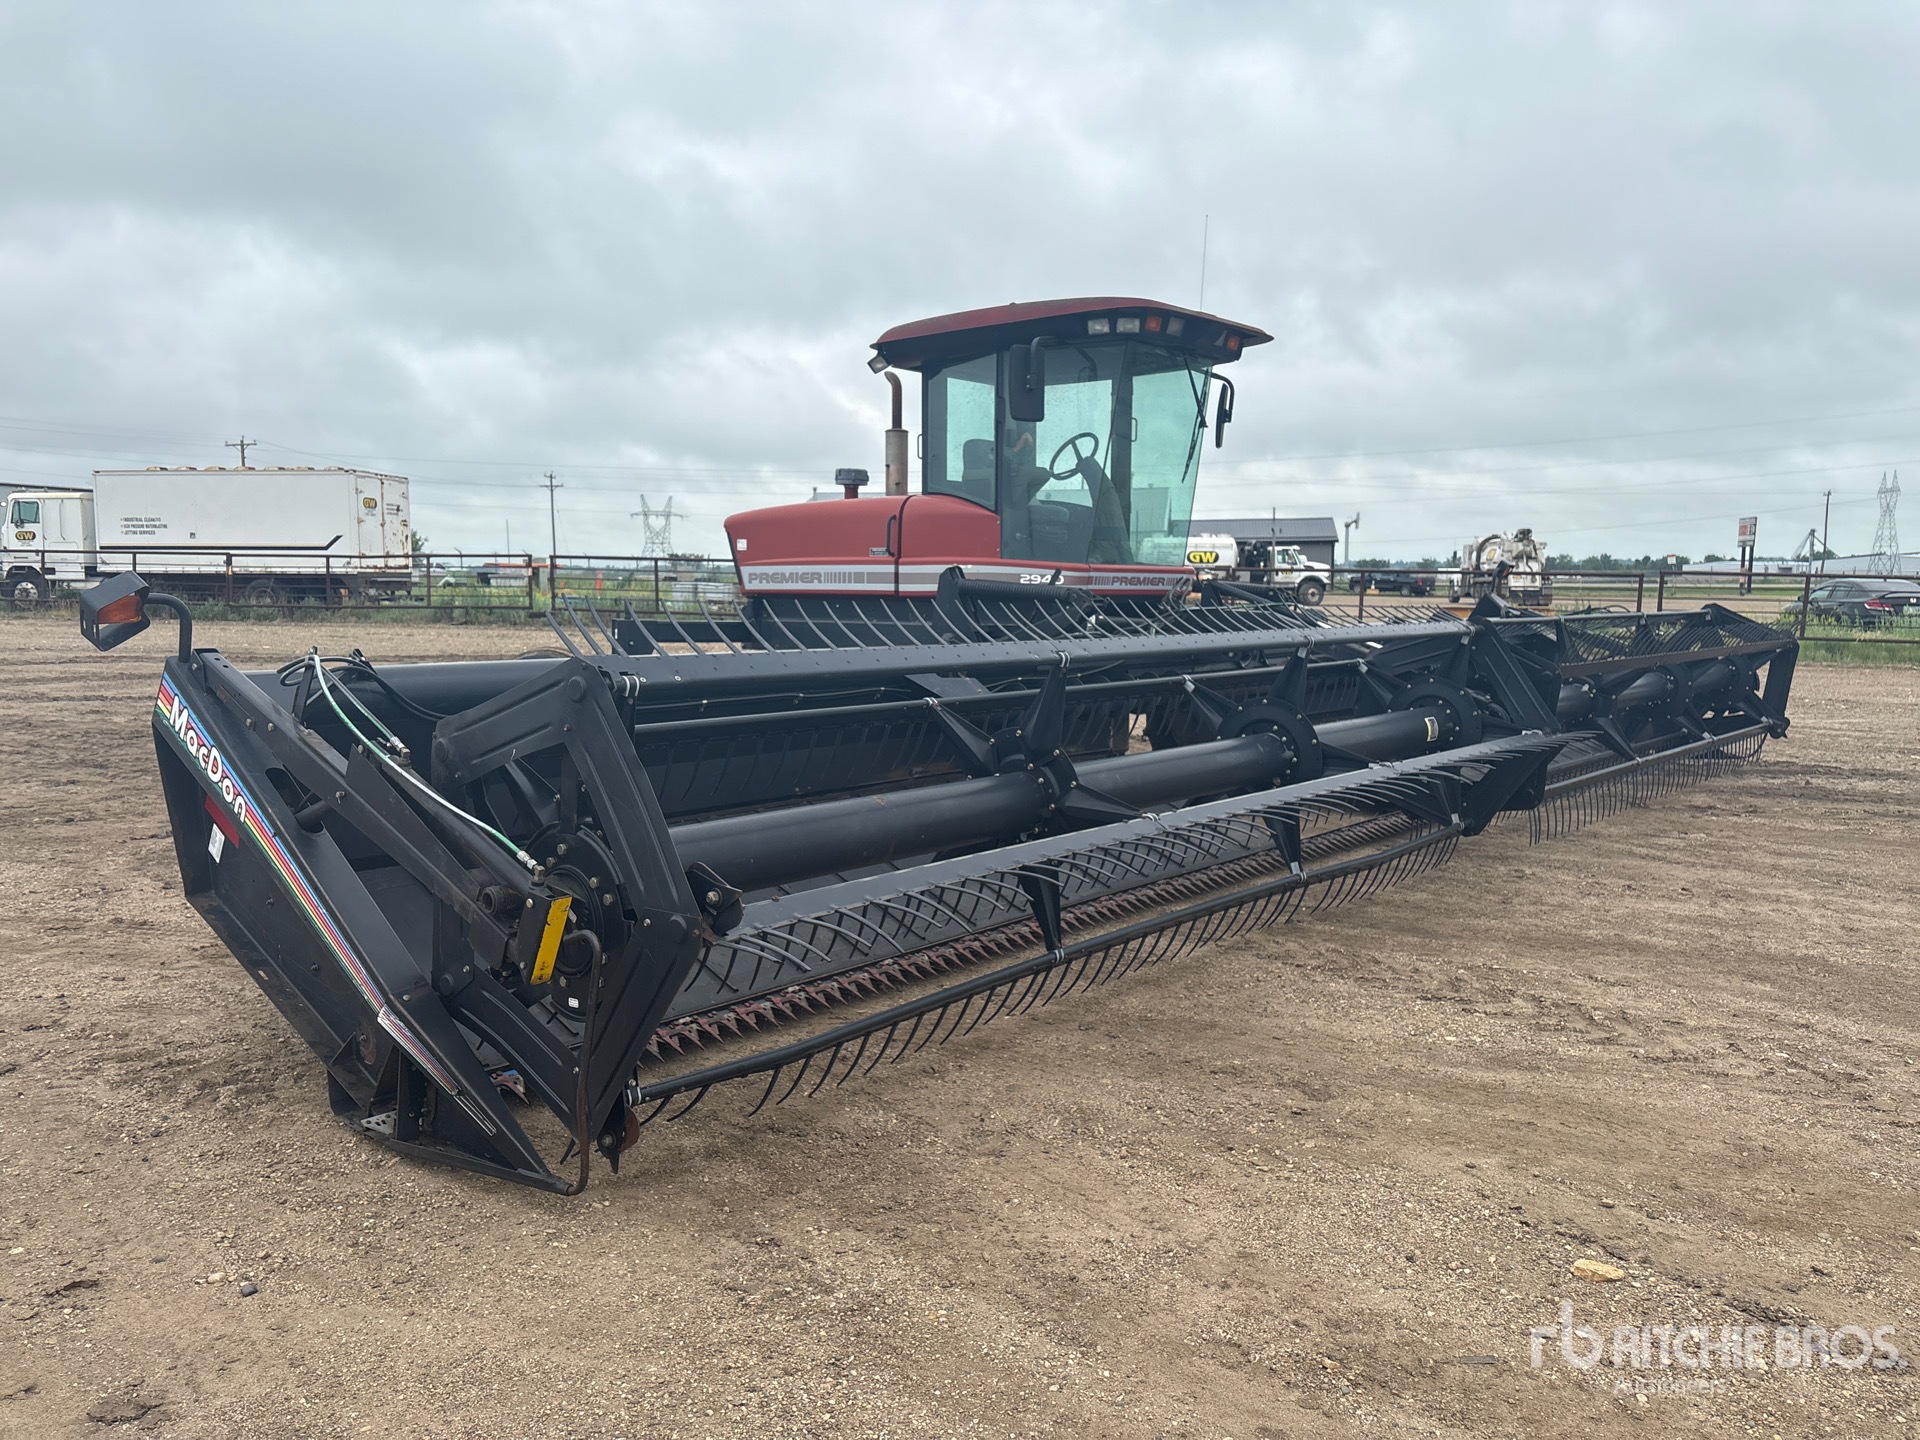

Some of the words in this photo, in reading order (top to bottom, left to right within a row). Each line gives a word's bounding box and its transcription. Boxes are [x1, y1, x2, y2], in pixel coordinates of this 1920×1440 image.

[16, 531, 34, 540] GW
[1189, 551, 1217, 563] GW
[748, 571, 823, 584] PREMIER
[1111, 575, 1166, 587] PREMIER
[169, 695, 247, 824] MacDon
